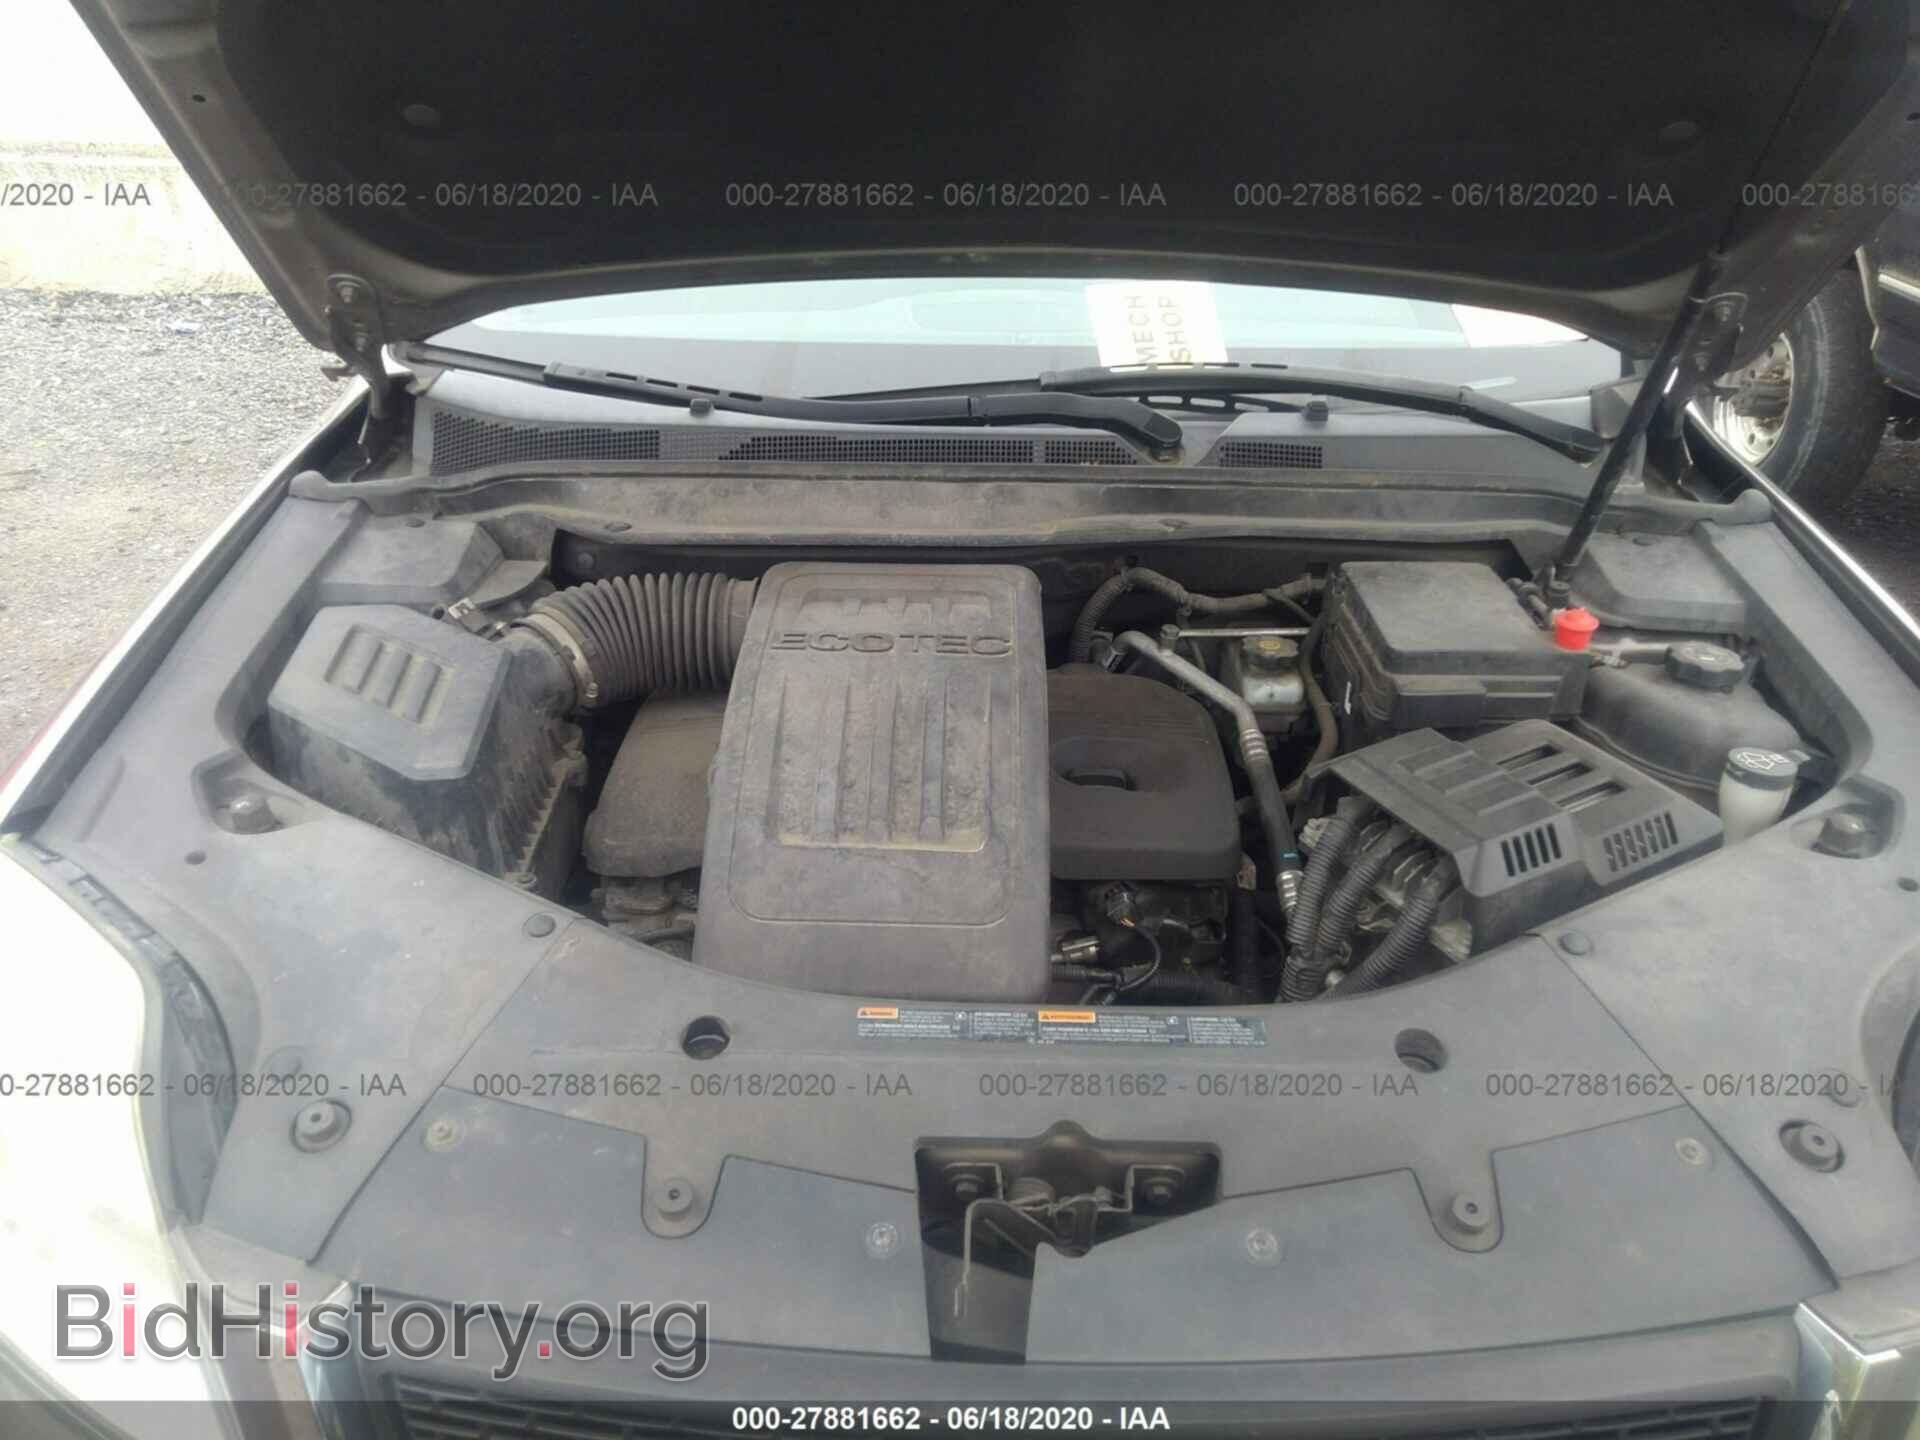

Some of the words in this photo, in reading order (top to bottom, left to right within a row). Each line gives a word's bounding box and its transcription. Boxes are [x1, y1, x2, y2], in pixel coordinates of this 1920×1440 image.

[1125, 295, 1158, 363] MECH
[1157, 295, 1192, 363] SHOP
[771, 632, 1013, 656] ECOTEC
